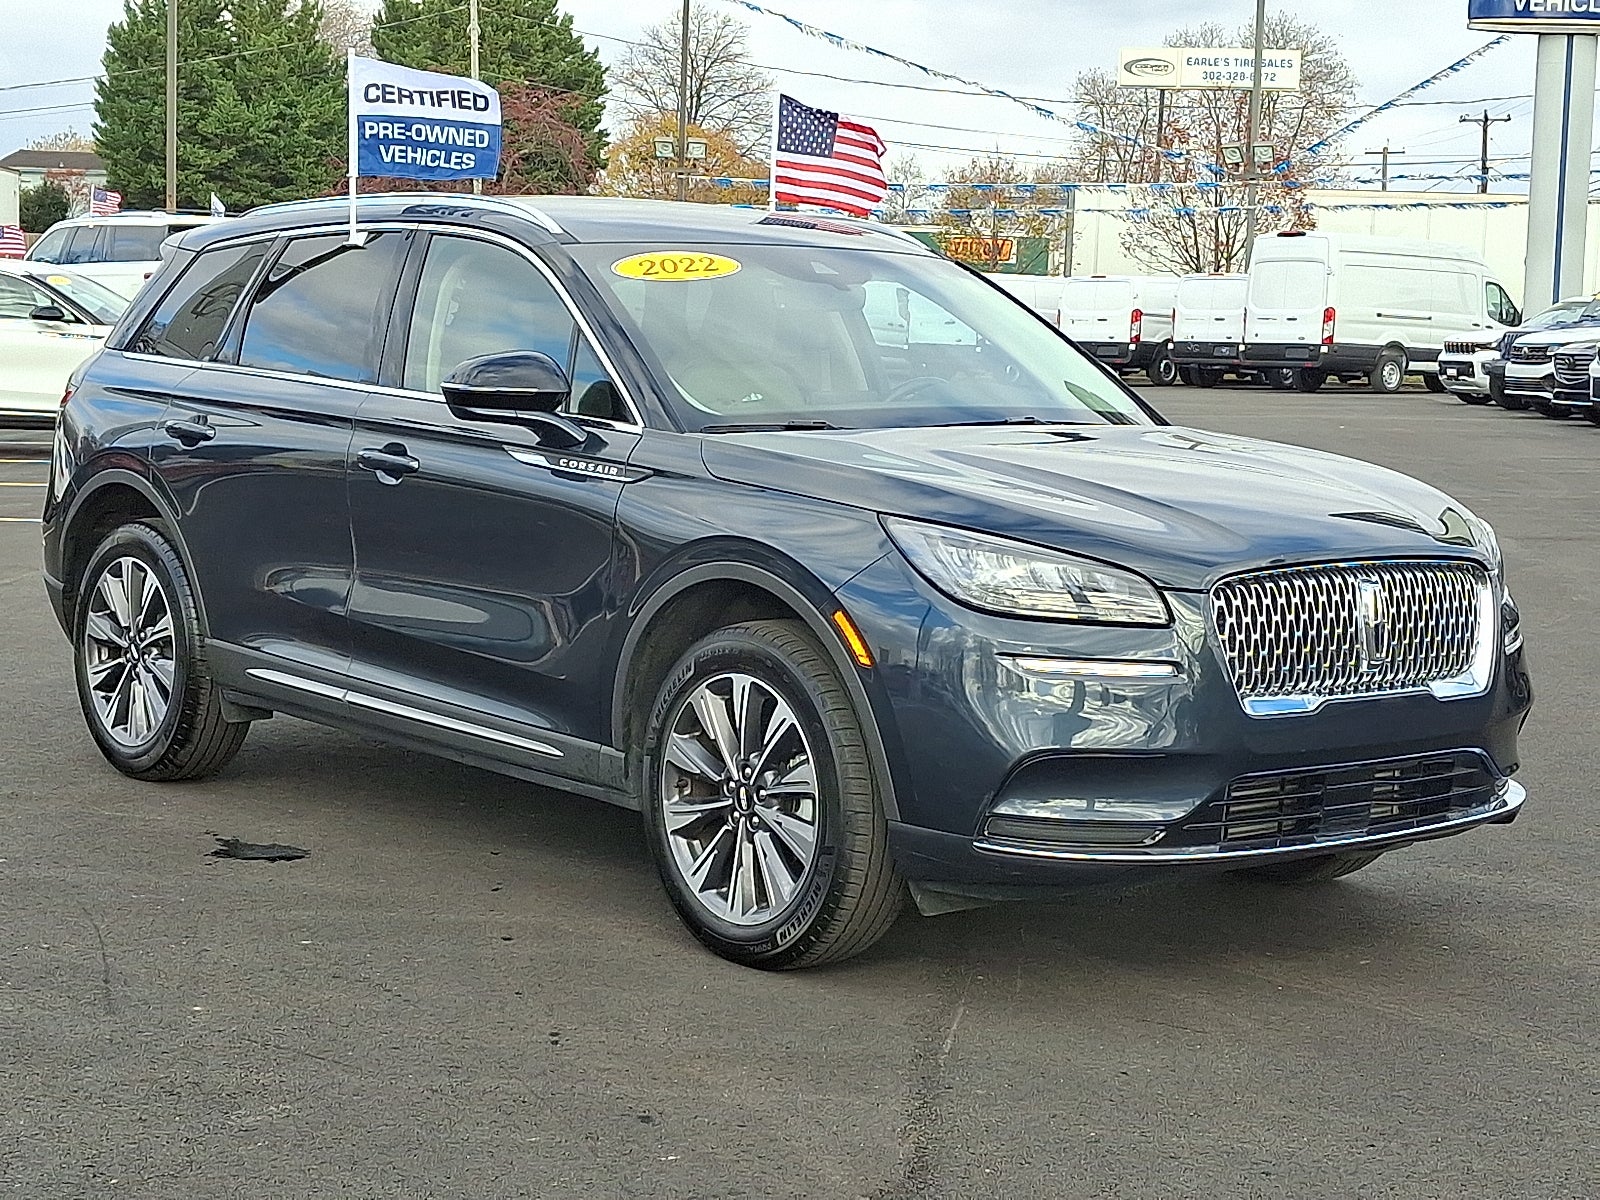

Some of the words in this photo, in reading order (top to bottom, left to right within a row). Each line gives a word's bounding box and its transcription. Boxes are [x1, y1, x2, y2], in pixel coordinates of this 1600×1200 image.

[1186, 57, 1230, 67] EARLE'S
[1261, 59, 1293, 68] SALES
[364, 83, 489, 112] CERTIFIED
[364, 121, 489, 148] PRE-OWNED
[378, 144, 476, 170] VEHICLES
[638, 256, 719, 276] 2022
[559, 458, 618, 476] CORSAIR
[653, 659, 694, 728] MICHELIN
[778, 880, 823, 943] MICHELIN
